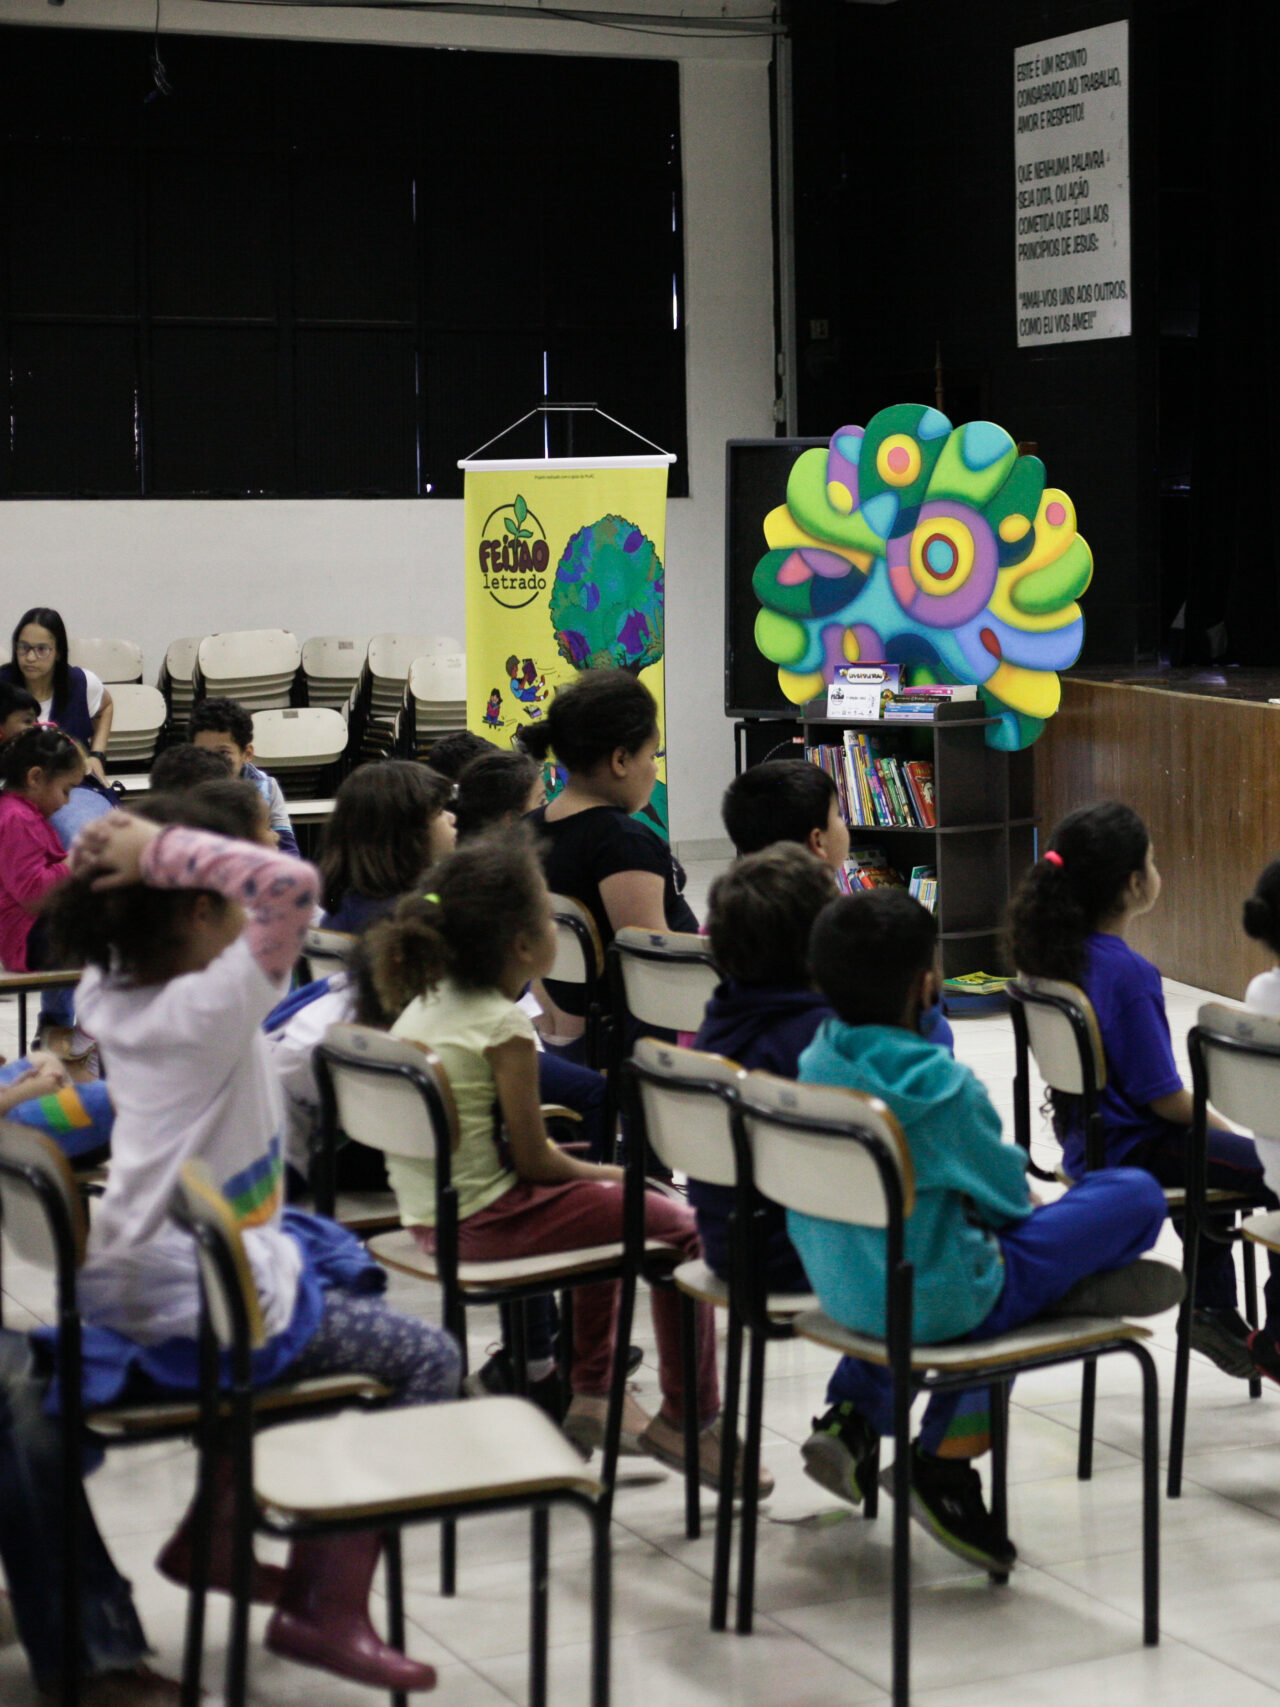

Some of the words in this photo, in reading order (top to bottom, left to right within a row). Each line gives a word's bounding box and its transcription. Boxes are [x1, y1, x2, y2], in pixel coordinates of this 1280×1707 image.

[1017, 61, 1034, 82] ESTE
[1041, 55, 1054, 76] UM
[1055, 47, 1087, 73] RECINTO
[1017, 80, 1066, 109] CONSAGRADO
[1068, 77, 1079, 96] AO
[1080, 67, 1121, 94] TRABALHO,
[1017, 113, 1039, 134] AMOR
[1040, 111, 1046, 130] E
[1046, 102, 1084, 128] RESPEITO!
[1018, 163, 1033, 184] QUE
[1034, 155, 1070, 180] NENHUMA
[1071, 149, 1105, 173] PALAVRA
[1018, 188, 1035, 210] SEJA
[1036, 185, 1053, 207] DITA,
[1055, 183, 1067, 203] OU
[1069, 176, 1089, 205] AÇÃO
[1018, 211, 1055, 236] COMETIDA
[1056, 209, 1072, 231] QUE
[1073, 206, 1091, 227] FUJA
[1093, 203, 1109, 224] AOS
[1018, 235, 1060, 261] PRINCÍPIOS
[1061, 236, 1072, 256] DE
[1072, 233, 1099, 255] JESUS:
[1019, 288, 1058, 310] "AMAI-VOS
[1059, 286, 1075, 306] UNS
[1076, 283, 1093, 304] AOS
[1094, 280, 1128, 302] OUTROS,
[1020, 316, 1042, 337] COMO
[1043, 314, 1054, 334] EU
[1055, 312, 1070, 333] VOS
[483, 573, 547, 590] letrado
